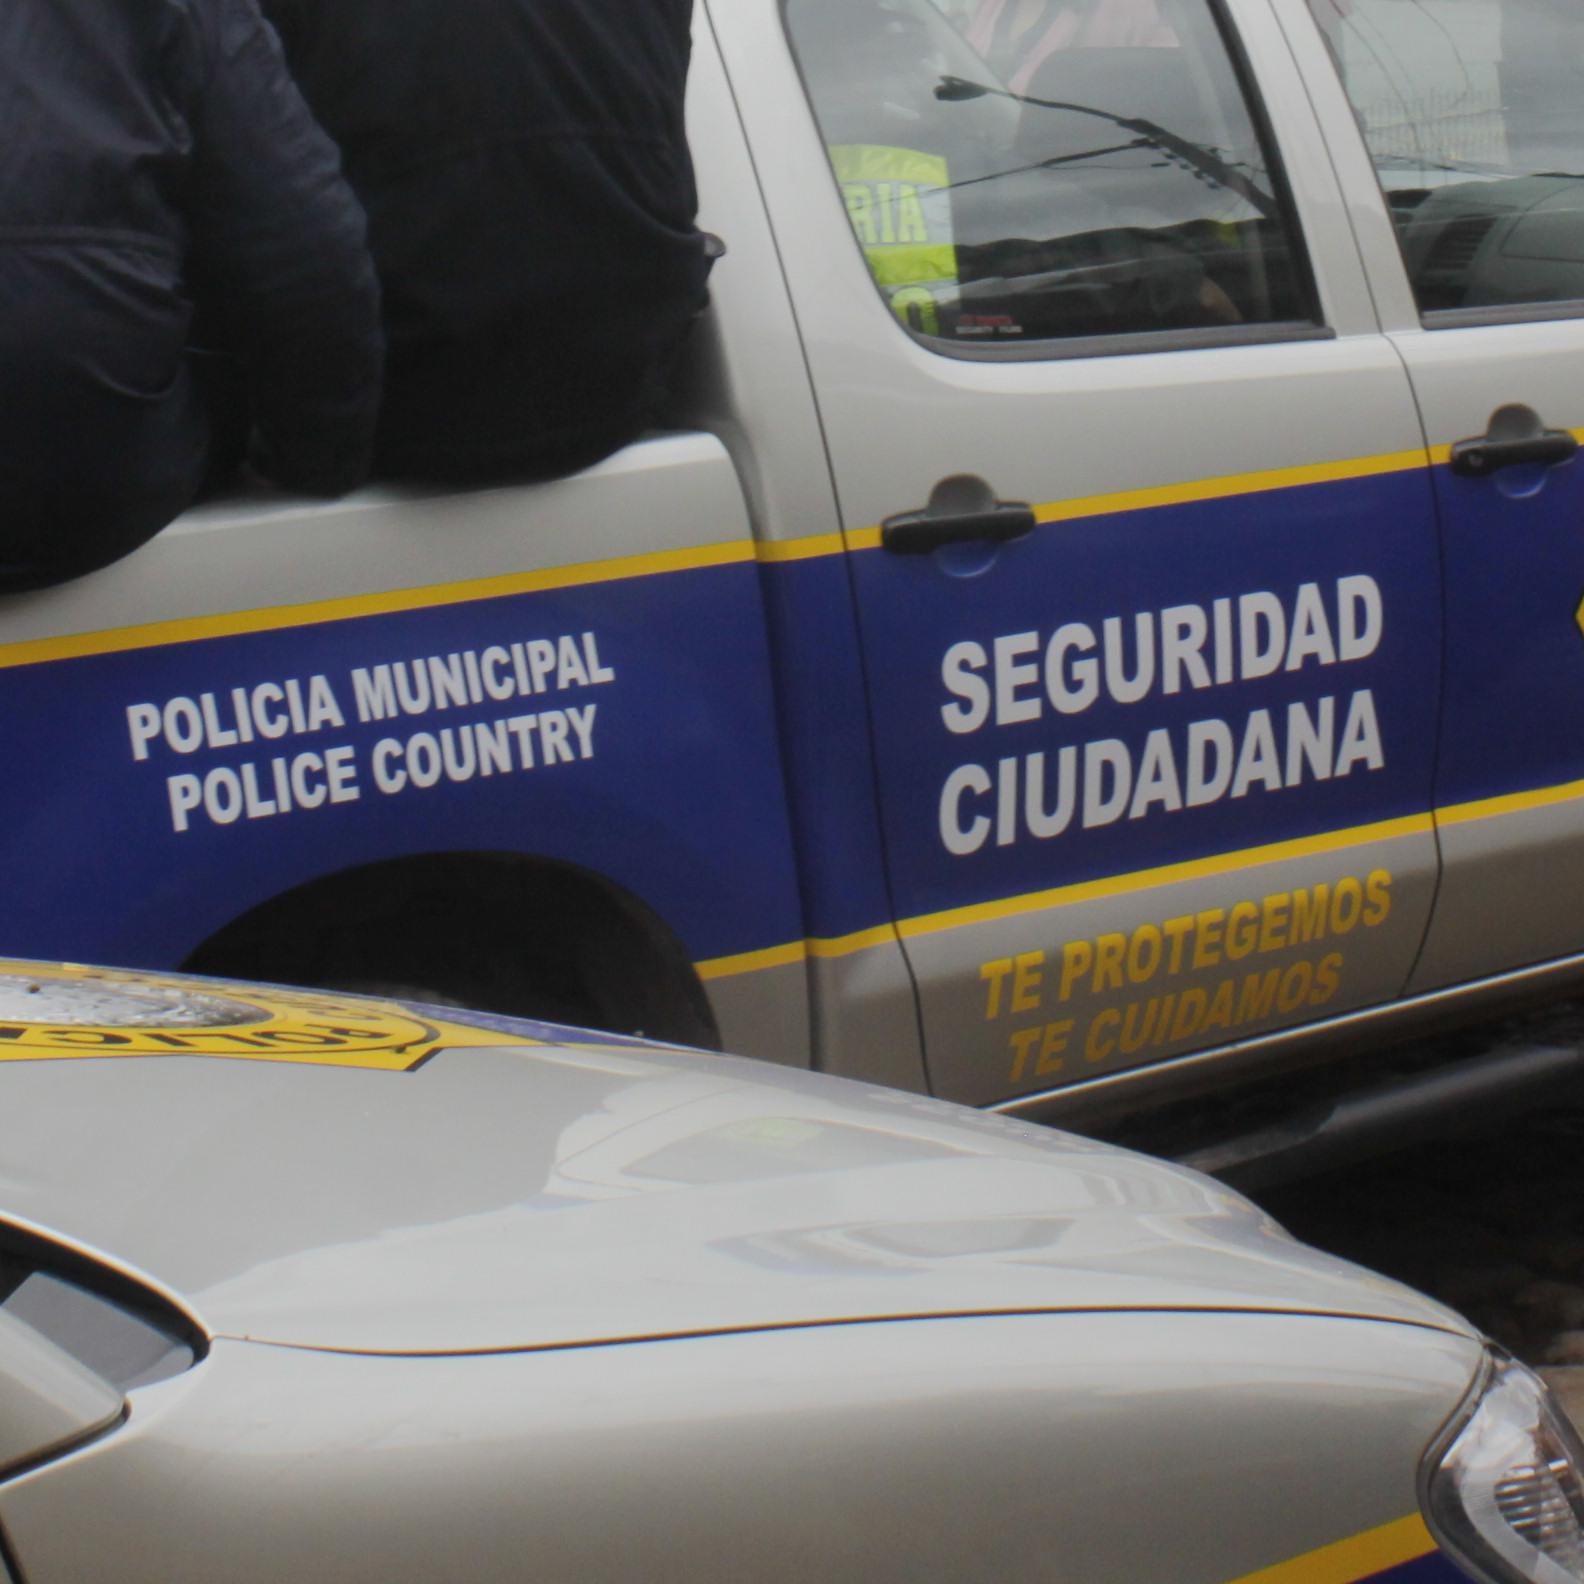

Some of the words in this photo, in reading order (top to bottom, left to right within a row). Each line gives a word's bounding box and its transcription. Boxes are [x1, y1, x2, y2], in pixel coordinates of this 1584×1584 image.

[127, 674, 345, 761] POLICIA
[351, 631, 614, 723] MUNICIPAL
[941, 574, 1383, 734] SEGURIDAD
[167, 745, 360, 832] POLICE
[372, 704, 597, 795] COUNTRY
[939, 689, 1385, 855] CIUDADANA
[980, 949, 1045, 1019] TE
[1058, 868, 1393, 1000] PROTEGEMOS
[1008, 1018, 1075, 1083] TE
[1084, 953, 1343, 1062] CUIDAMOS
